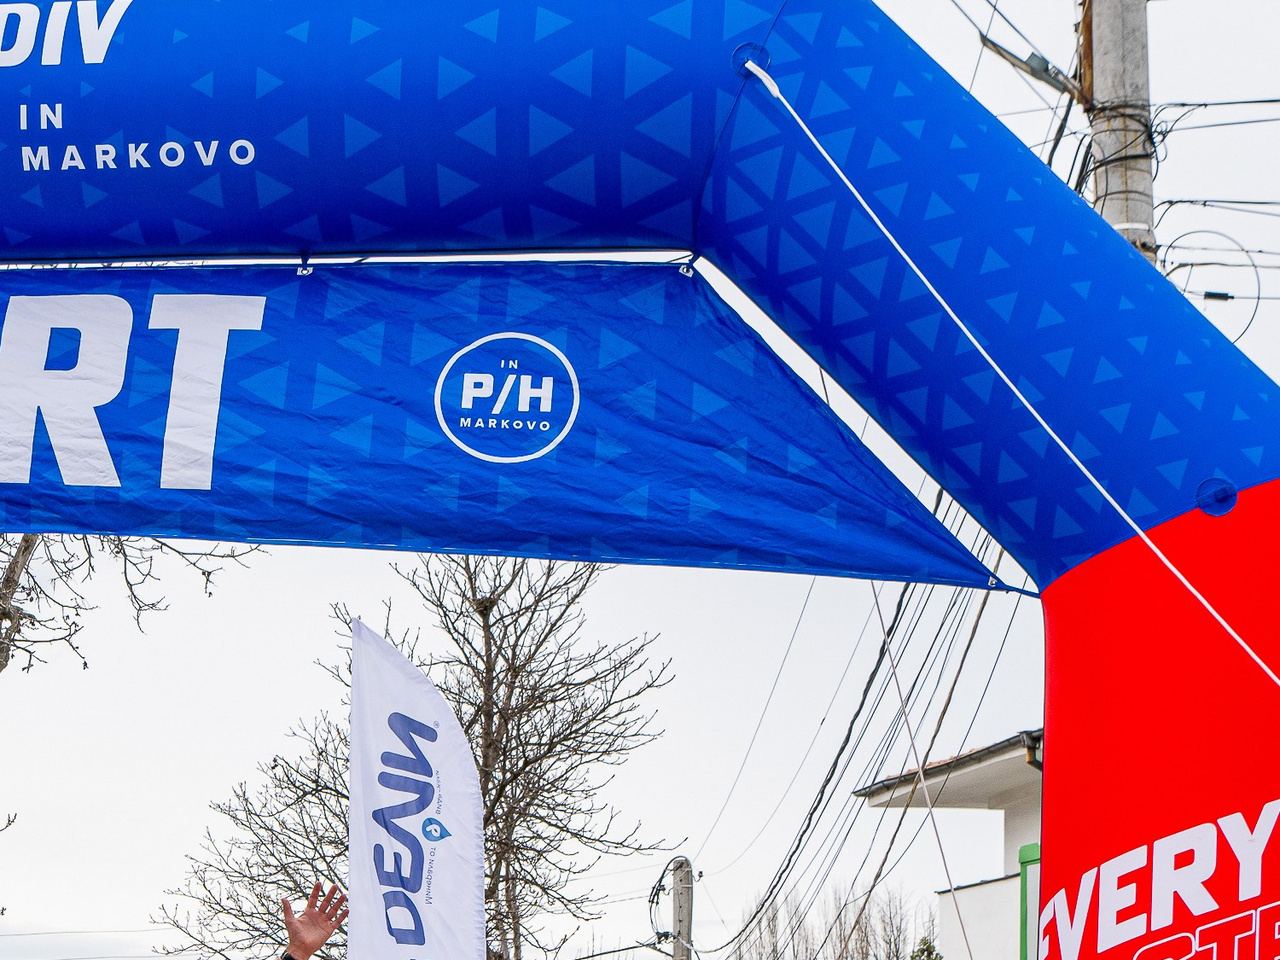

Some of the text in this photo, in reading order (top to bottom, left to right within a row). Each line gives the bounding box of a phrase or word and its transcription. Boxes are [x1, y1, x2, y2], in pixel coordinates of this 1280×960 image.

[20, 104, 63, 130] IN
[21, 139, 256, 172] MARKOVO
[500, 359, 518, 370] IN
[460, 373, 552, 415] P/H
[459, 417, 551, 432] MARKOVO
